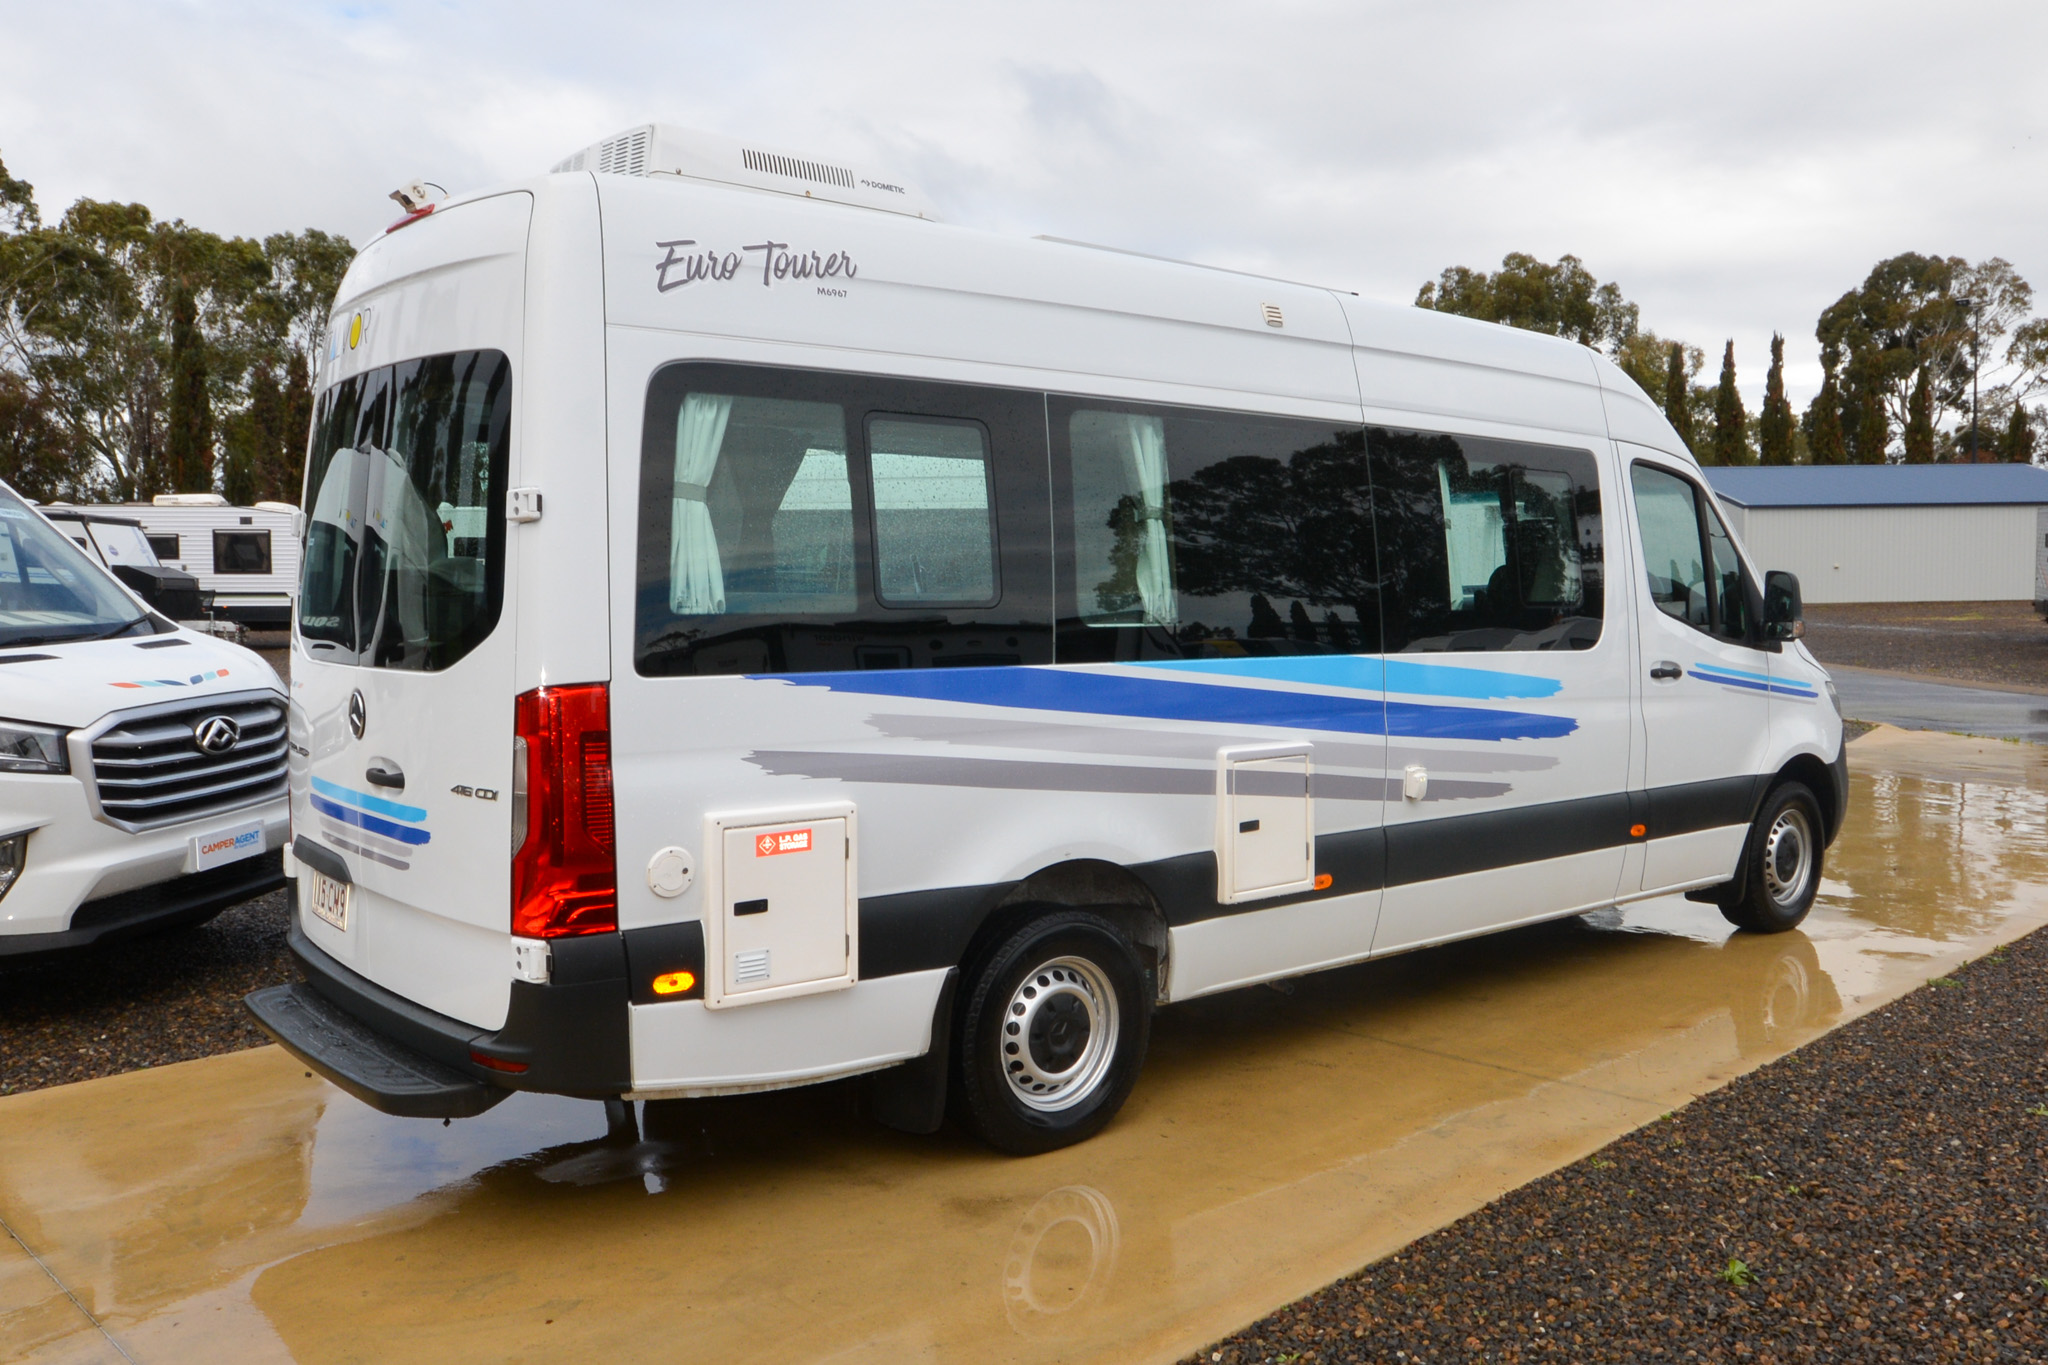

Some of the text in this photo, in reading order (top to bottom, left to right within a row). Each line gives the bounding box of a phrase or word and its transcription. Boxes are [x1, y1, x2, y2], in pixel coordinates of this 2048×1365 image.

[871, 181, 905, 194] DOMETIC
[656, 239, 857, 293] Euro Tourer
[817, 287, 847, 298] M6967
[450, 784, 499, 801] 416 CDI
[793, 832, 808, 841] GAS
[779, 840, 808, 851] STORAGE
